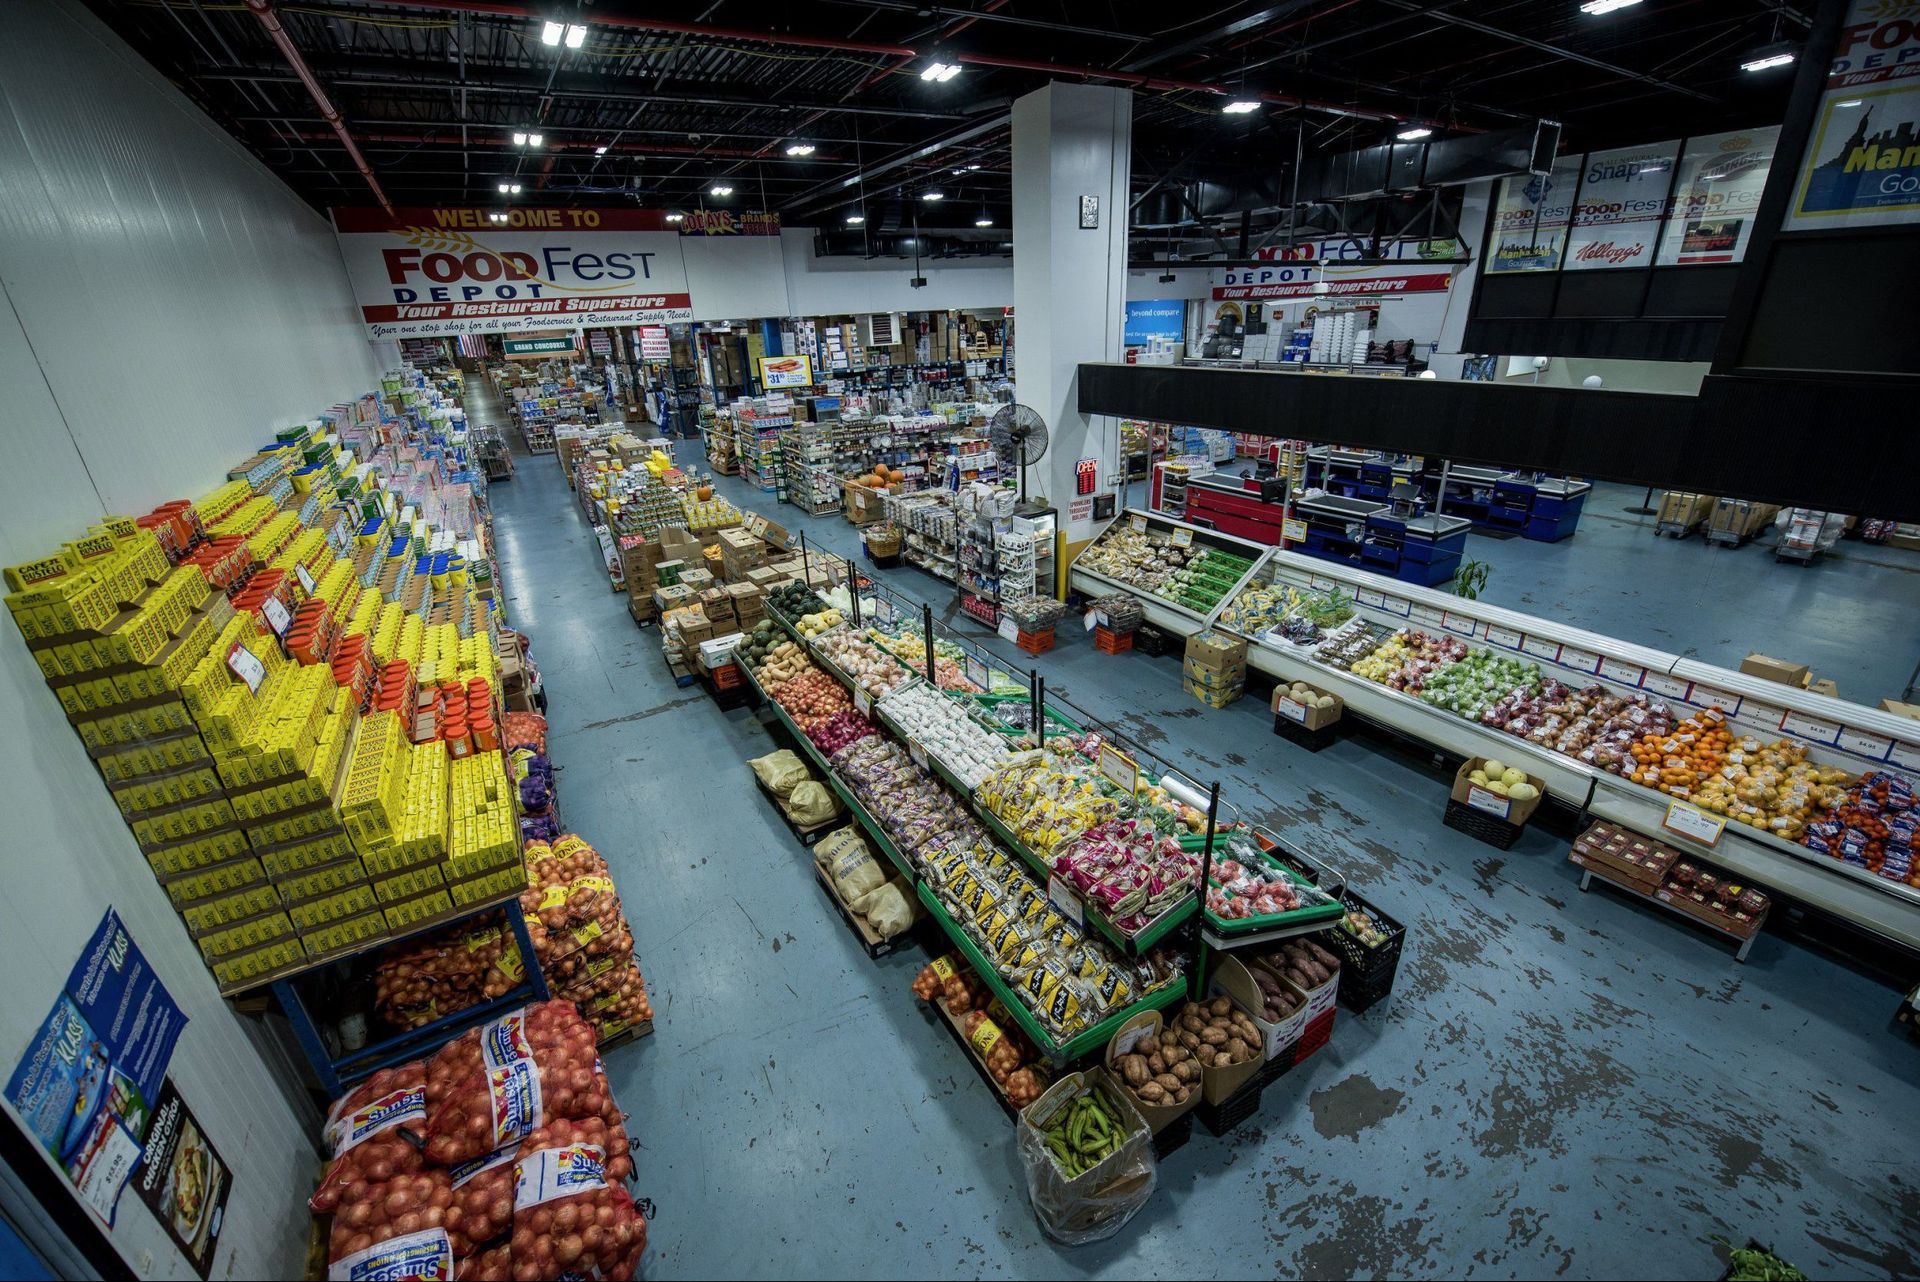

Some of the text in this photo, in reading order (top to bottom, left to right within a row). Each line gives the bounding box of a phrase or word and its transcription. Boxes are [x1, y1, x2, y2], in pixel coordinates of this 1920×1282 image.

[568, 209, 601, 227] TO
[1576, 241, 1645, 263] Kellogg's
[382, 248, 539, 285] FOOD
[1225, 267, 1313, 286] DEPOT
[394, 283, 543, 304] DEPOT
[1222, 278, 1408, 298] Your Restauran Superstore
[396, 295, 667, 319] Your Restaurant Superstore
[1131, 309, 1180, 319] beyond compare
[371, 309, 691, 338] Your one stop shop for all your Foodservice & Restaurant Supply Needs
[514, 341, 566, 351] GRAND CONCOURSE
[1076, 459, 1098, 475] OPEN
[22, 564, 66, 581] BUSTELO
[1858, 740, 1876, 750] $4.95
[56, 1015, 84, 1067] KLASS
[502, 1023, 519, 1061] Sunse
[142, 1103, 170, 1165] ORIGINAL
[142, 1134, 168, 1191] CHICKEN
